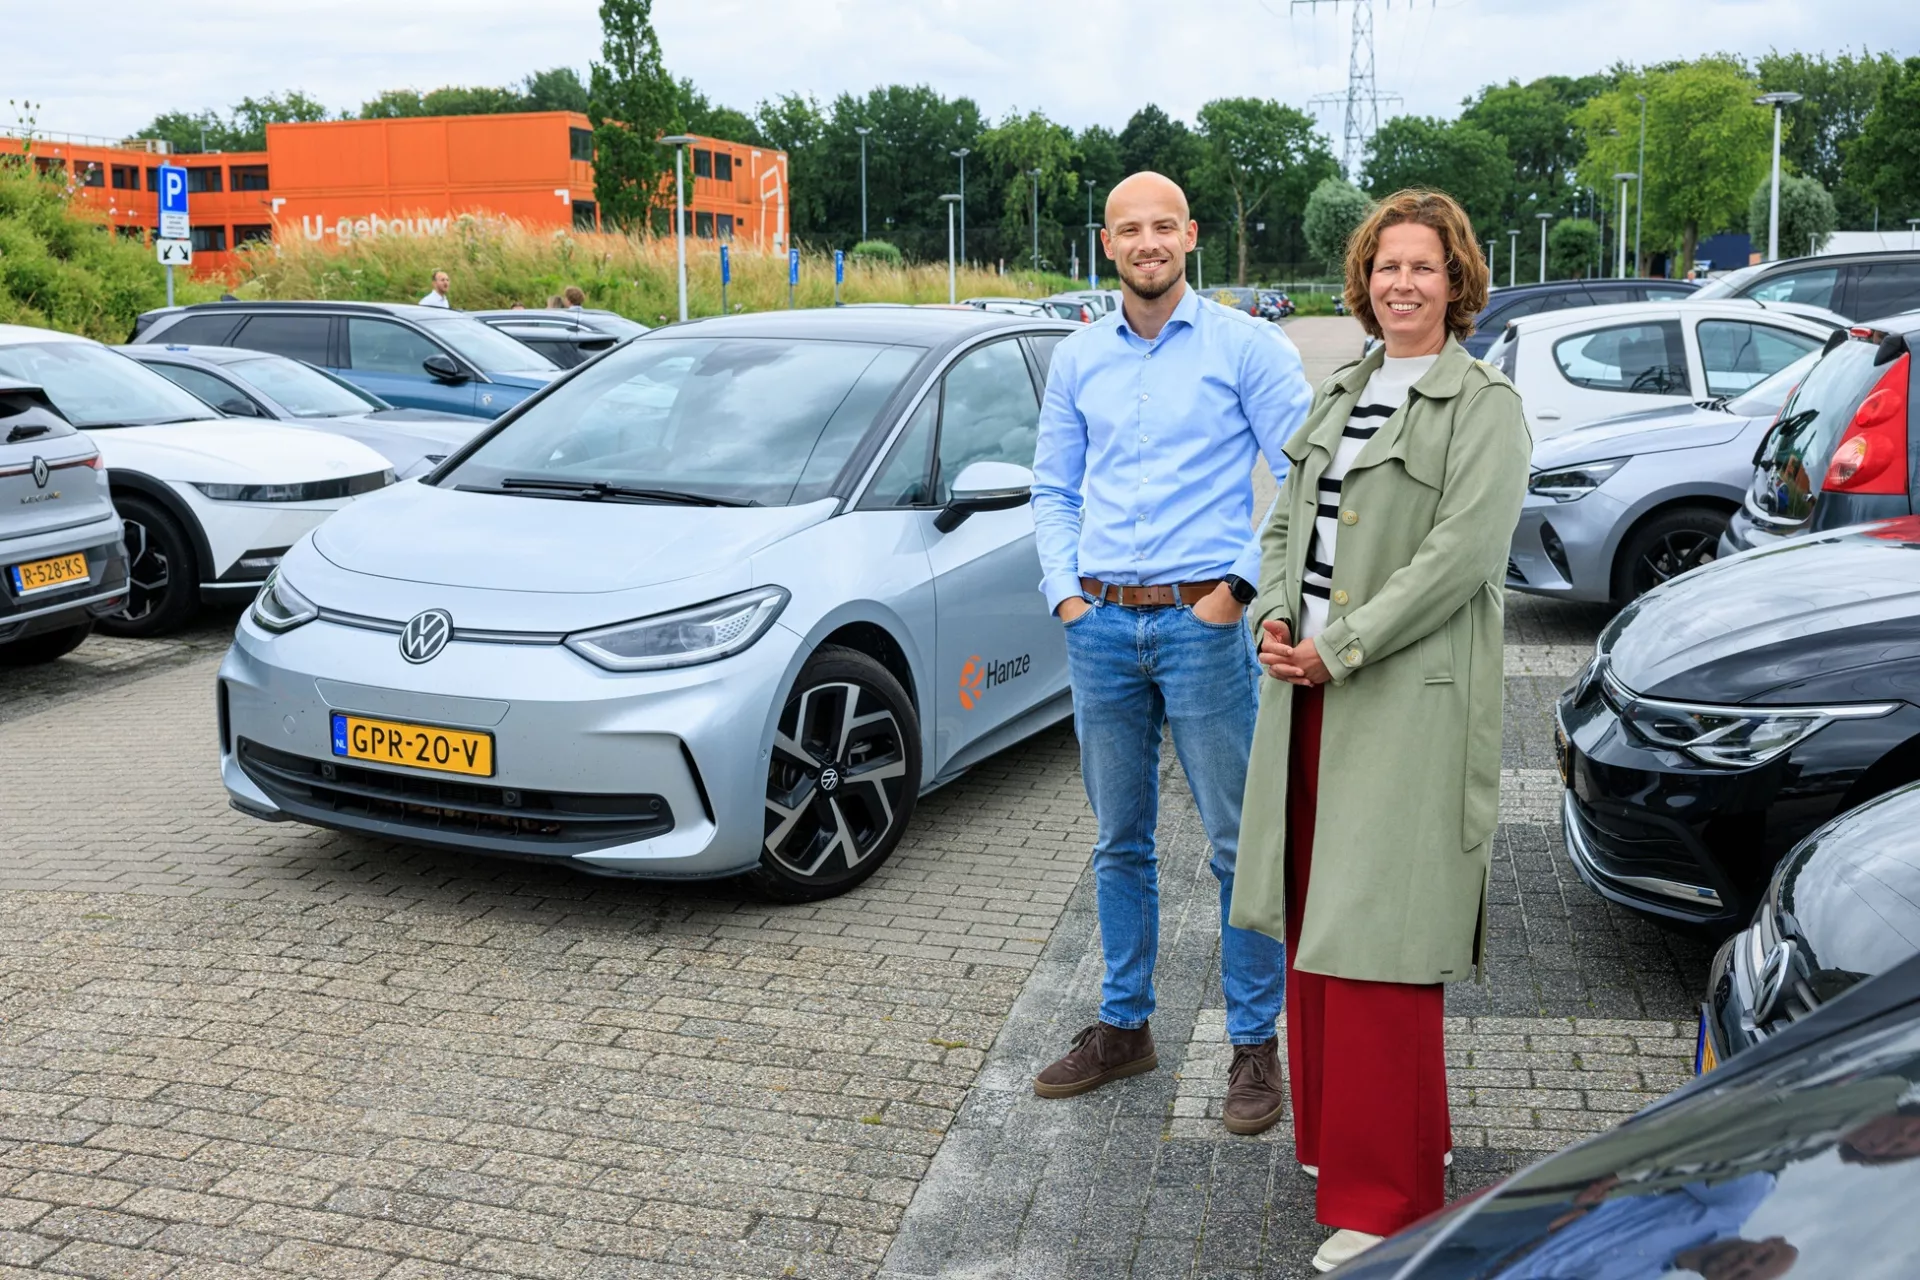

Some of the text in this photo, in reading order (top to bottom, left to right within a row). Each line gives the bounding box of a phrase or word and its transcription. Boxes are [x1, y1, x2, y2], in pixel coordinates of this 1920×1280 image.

[166, 172, 183, 208] P
[302, 213, 449, 246] U-gebouw
[23, 557, 84, 586] R-528-KS
[986, 653, 1031, 689] Hanze
[335, 738, 347, 749] NL
[352, 724, 479, 768] GPR-20-V
